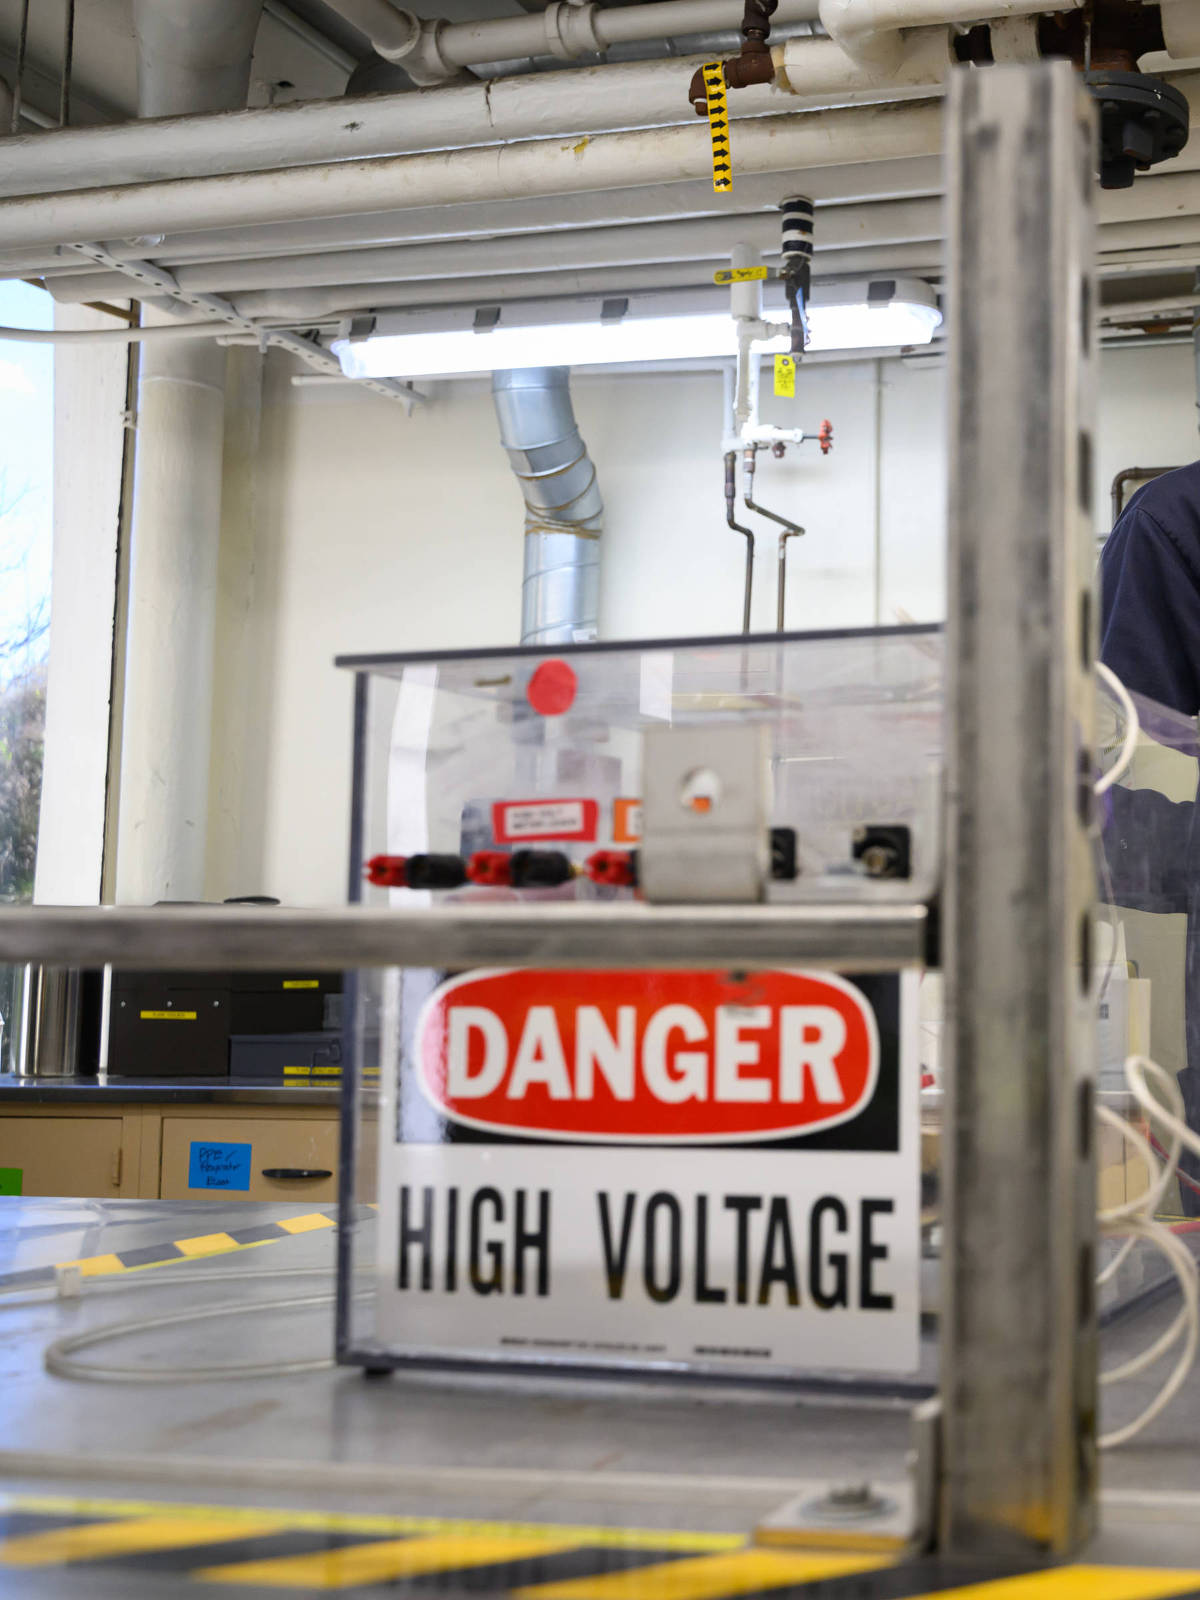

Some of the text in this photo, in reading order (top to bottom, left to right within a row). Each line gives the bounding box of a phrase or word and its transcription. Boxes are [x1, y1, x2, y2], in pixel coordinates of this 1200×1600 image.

[446, 1004, 847, 1104] DANGER
[399, 1186, 895, 1310] HIGH VOLTAGE
